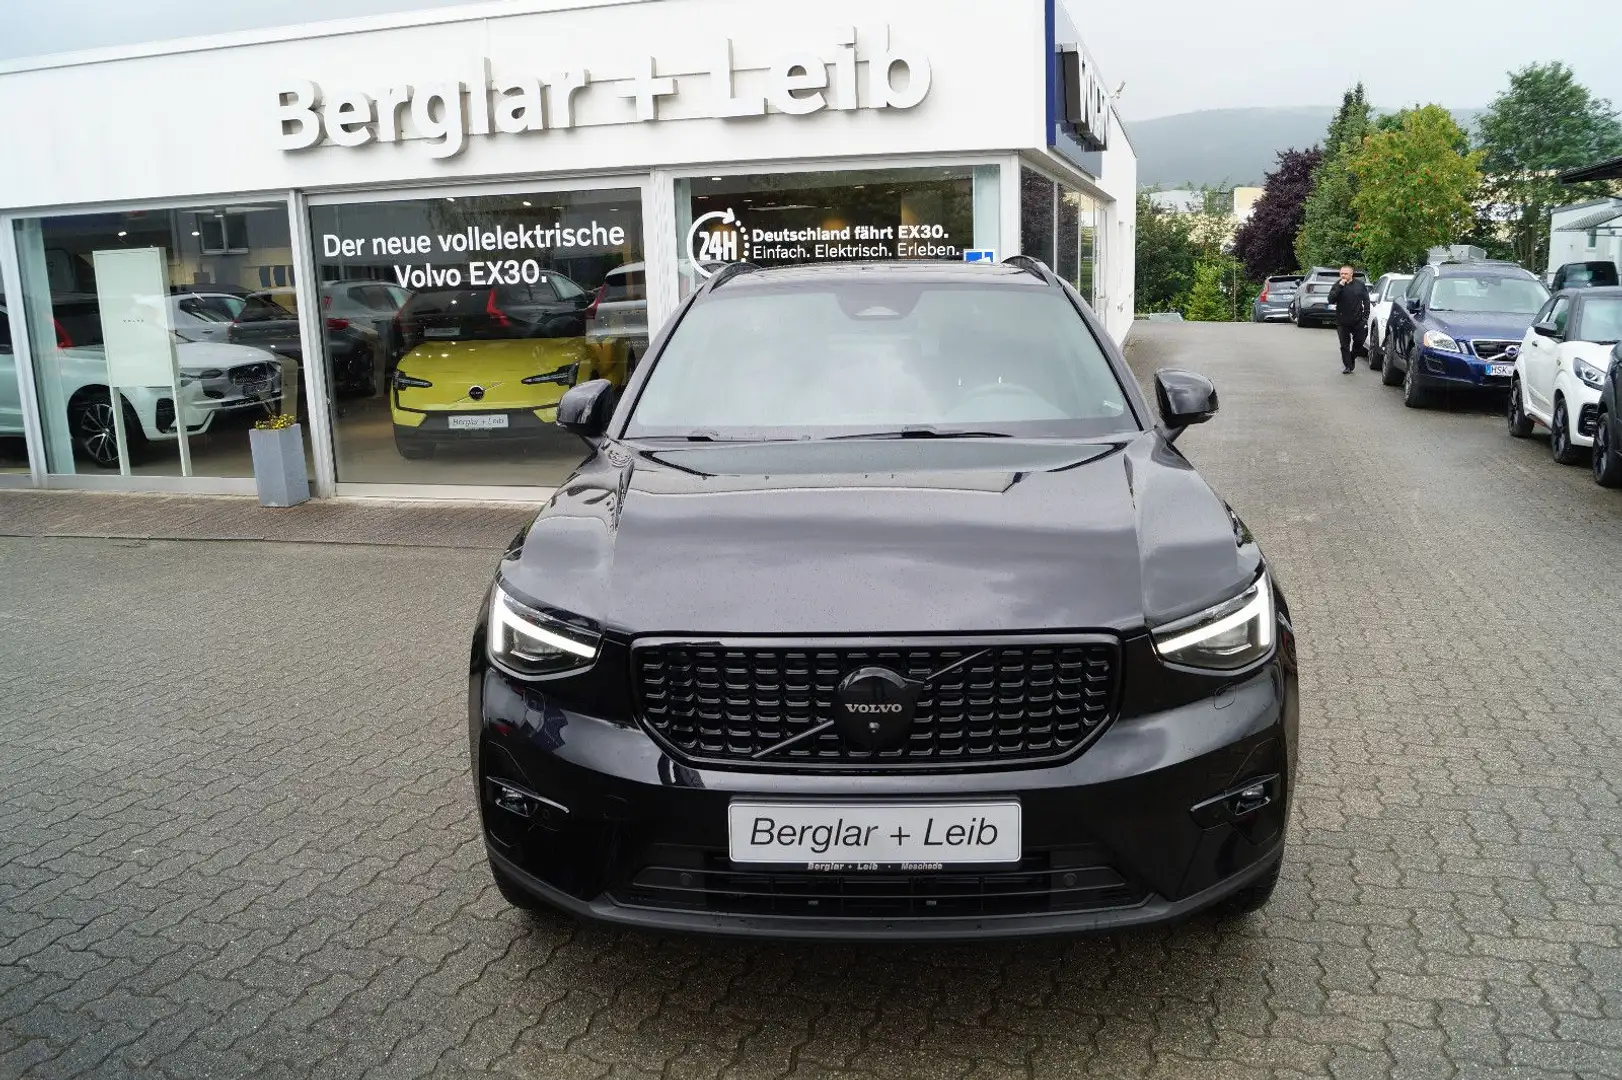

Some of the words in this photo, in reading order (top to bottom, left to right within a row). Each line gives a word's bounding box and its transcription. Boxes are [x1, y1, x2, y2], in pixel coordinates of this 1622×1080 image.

[276, 56, 590, 160] Berglar
[614, 55, 678, 121] +
[710, 23, 933, 119] Leib
[323, 233, 365, 257] Der
[372, 234, 431, 255] neue
[437, 220, 625, 252] vollelektrische
[752, 226, 850, 242] Deutschland
[854, 226, 893, 240] fährt
[898, 224, 949, 239] EX30.
[699, 231, 737, 261] 24H
[753, 244, 810, 260] Einfach.
[815, 242, 892, 258] Elektrisch.
[897, 241, 960, 257] Erleben.
[394, 262, 462, 288] Volvo
[469, 258, 547, 286] EX30.
[1491, 365, 1508, 374] HSK
[845, 703, 902, 713] VOLVO
[750, 817, 878, 853] Berglar
[890, 826, 911, 846] +
[924, 817, 998, 846] Leib
[807, 862, 845, 872] Berglar
[857, 862, 878, 871] Leib
